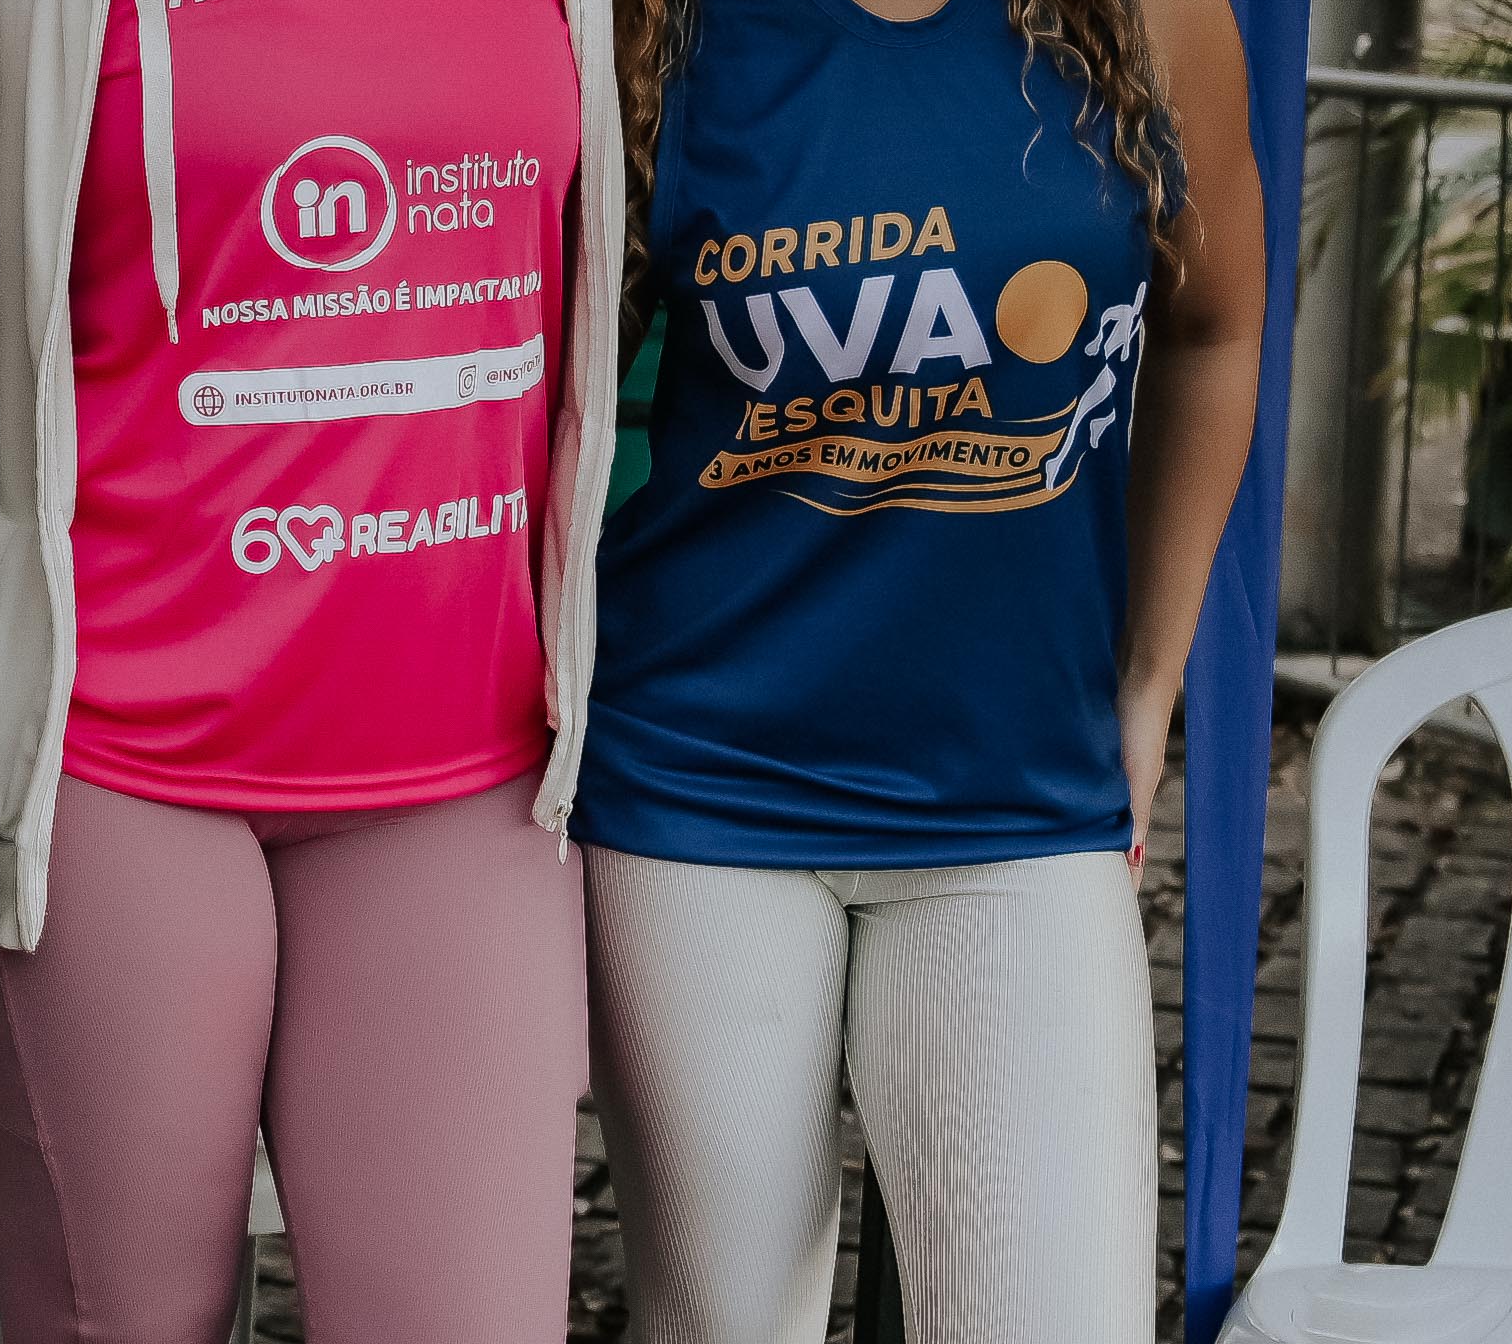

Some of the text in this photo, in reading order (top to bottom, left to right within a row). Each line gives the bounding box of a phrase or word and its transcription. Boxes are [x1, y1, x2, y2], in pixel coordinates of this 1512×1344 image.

[406, 150, 540, 195] instituto
[406, 194, 494, 234] nata
[694, 207, 955, 285] CORRIDA
[202, 298, 288, 328] NOSSA
[293, 286, 391, 320] MISSÃO
[398, 281, 411, 310] É
[416, 276, 520, 310] IMPACTAR
[700, 268, 992, 391] UVA
[235, 382, 413, 406] INSTITUTONATA.ORG.BR
[736, 377, 992, 441] ESQUITA
[731, 446, 811, 479] ANOS
[821, 444, 856, 467] EM
[857, 442, 1031, 473] MOVIMENTO
